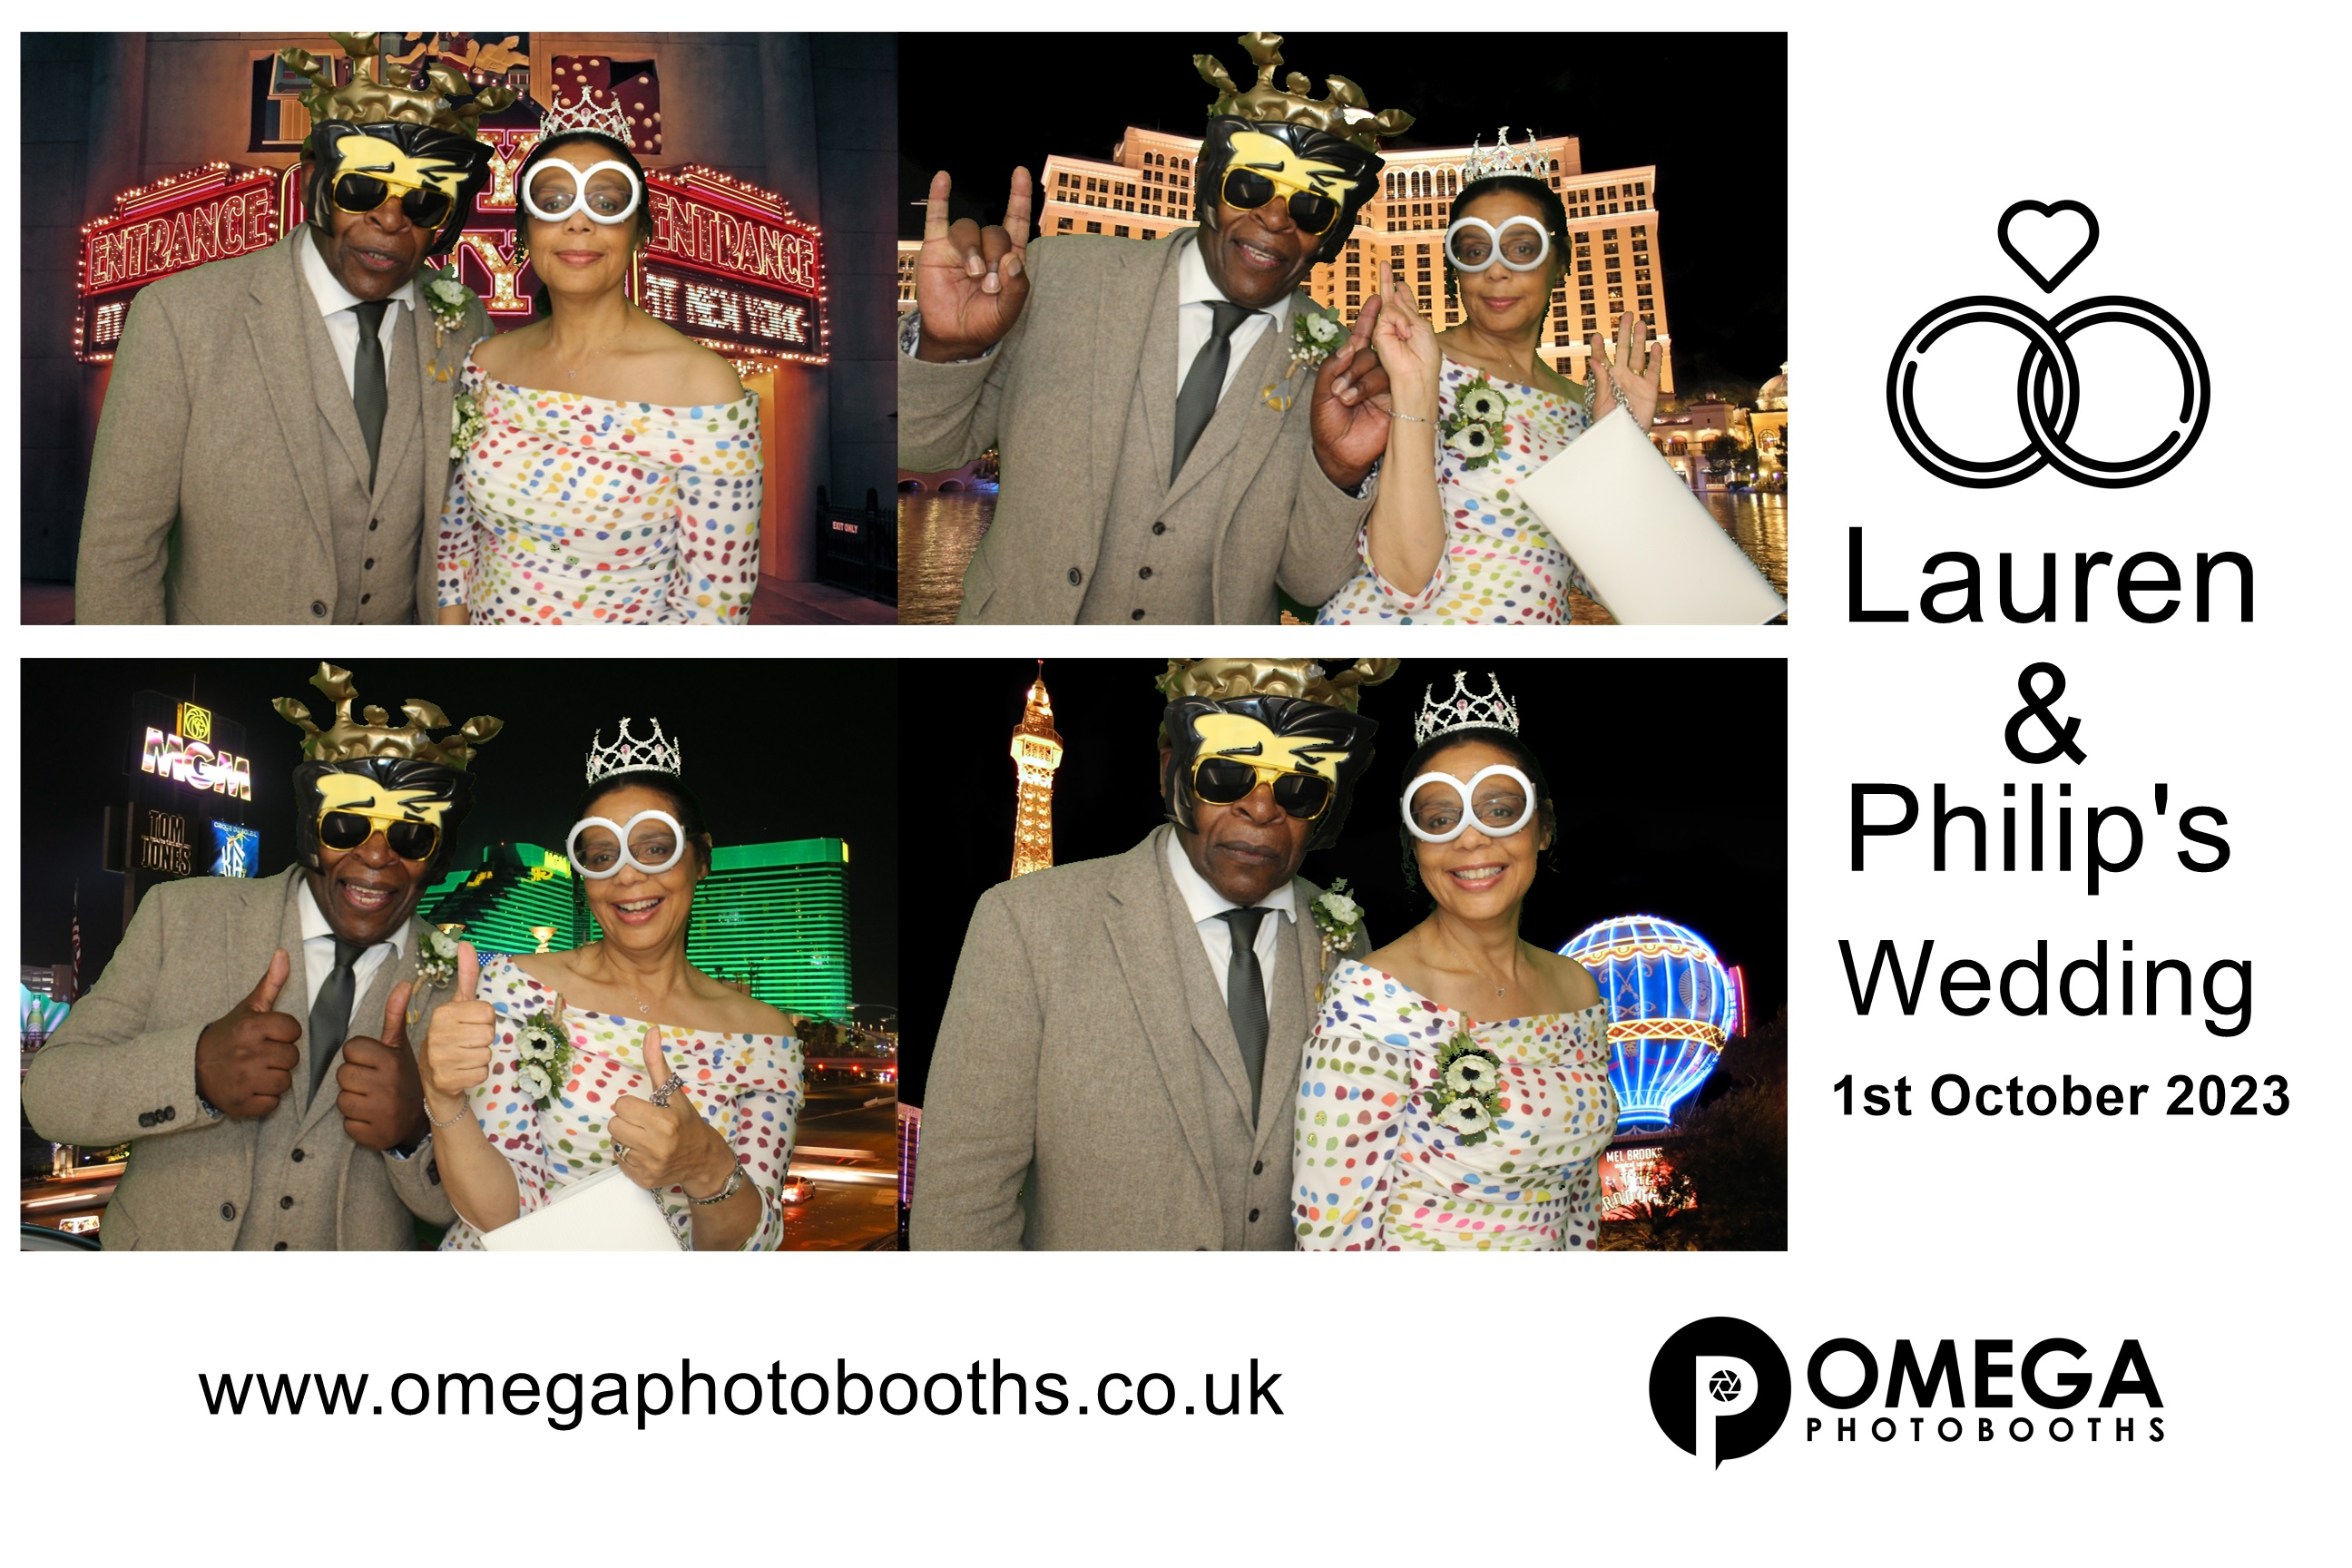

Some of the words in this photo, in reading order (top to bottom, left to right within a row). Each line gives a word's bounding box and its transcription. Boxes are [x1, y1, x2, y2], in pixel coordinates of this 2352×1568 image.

[89, 187, 270, 286] ENTRANCE
[648, 188, 815, 289] ENTRANCE
[141, 726, 252, 801] MGM
[149, 809, 185, 844] TOM
[142, 840, 191, 876] JONES
[1606, 1151, 1625, 1162] MEL
